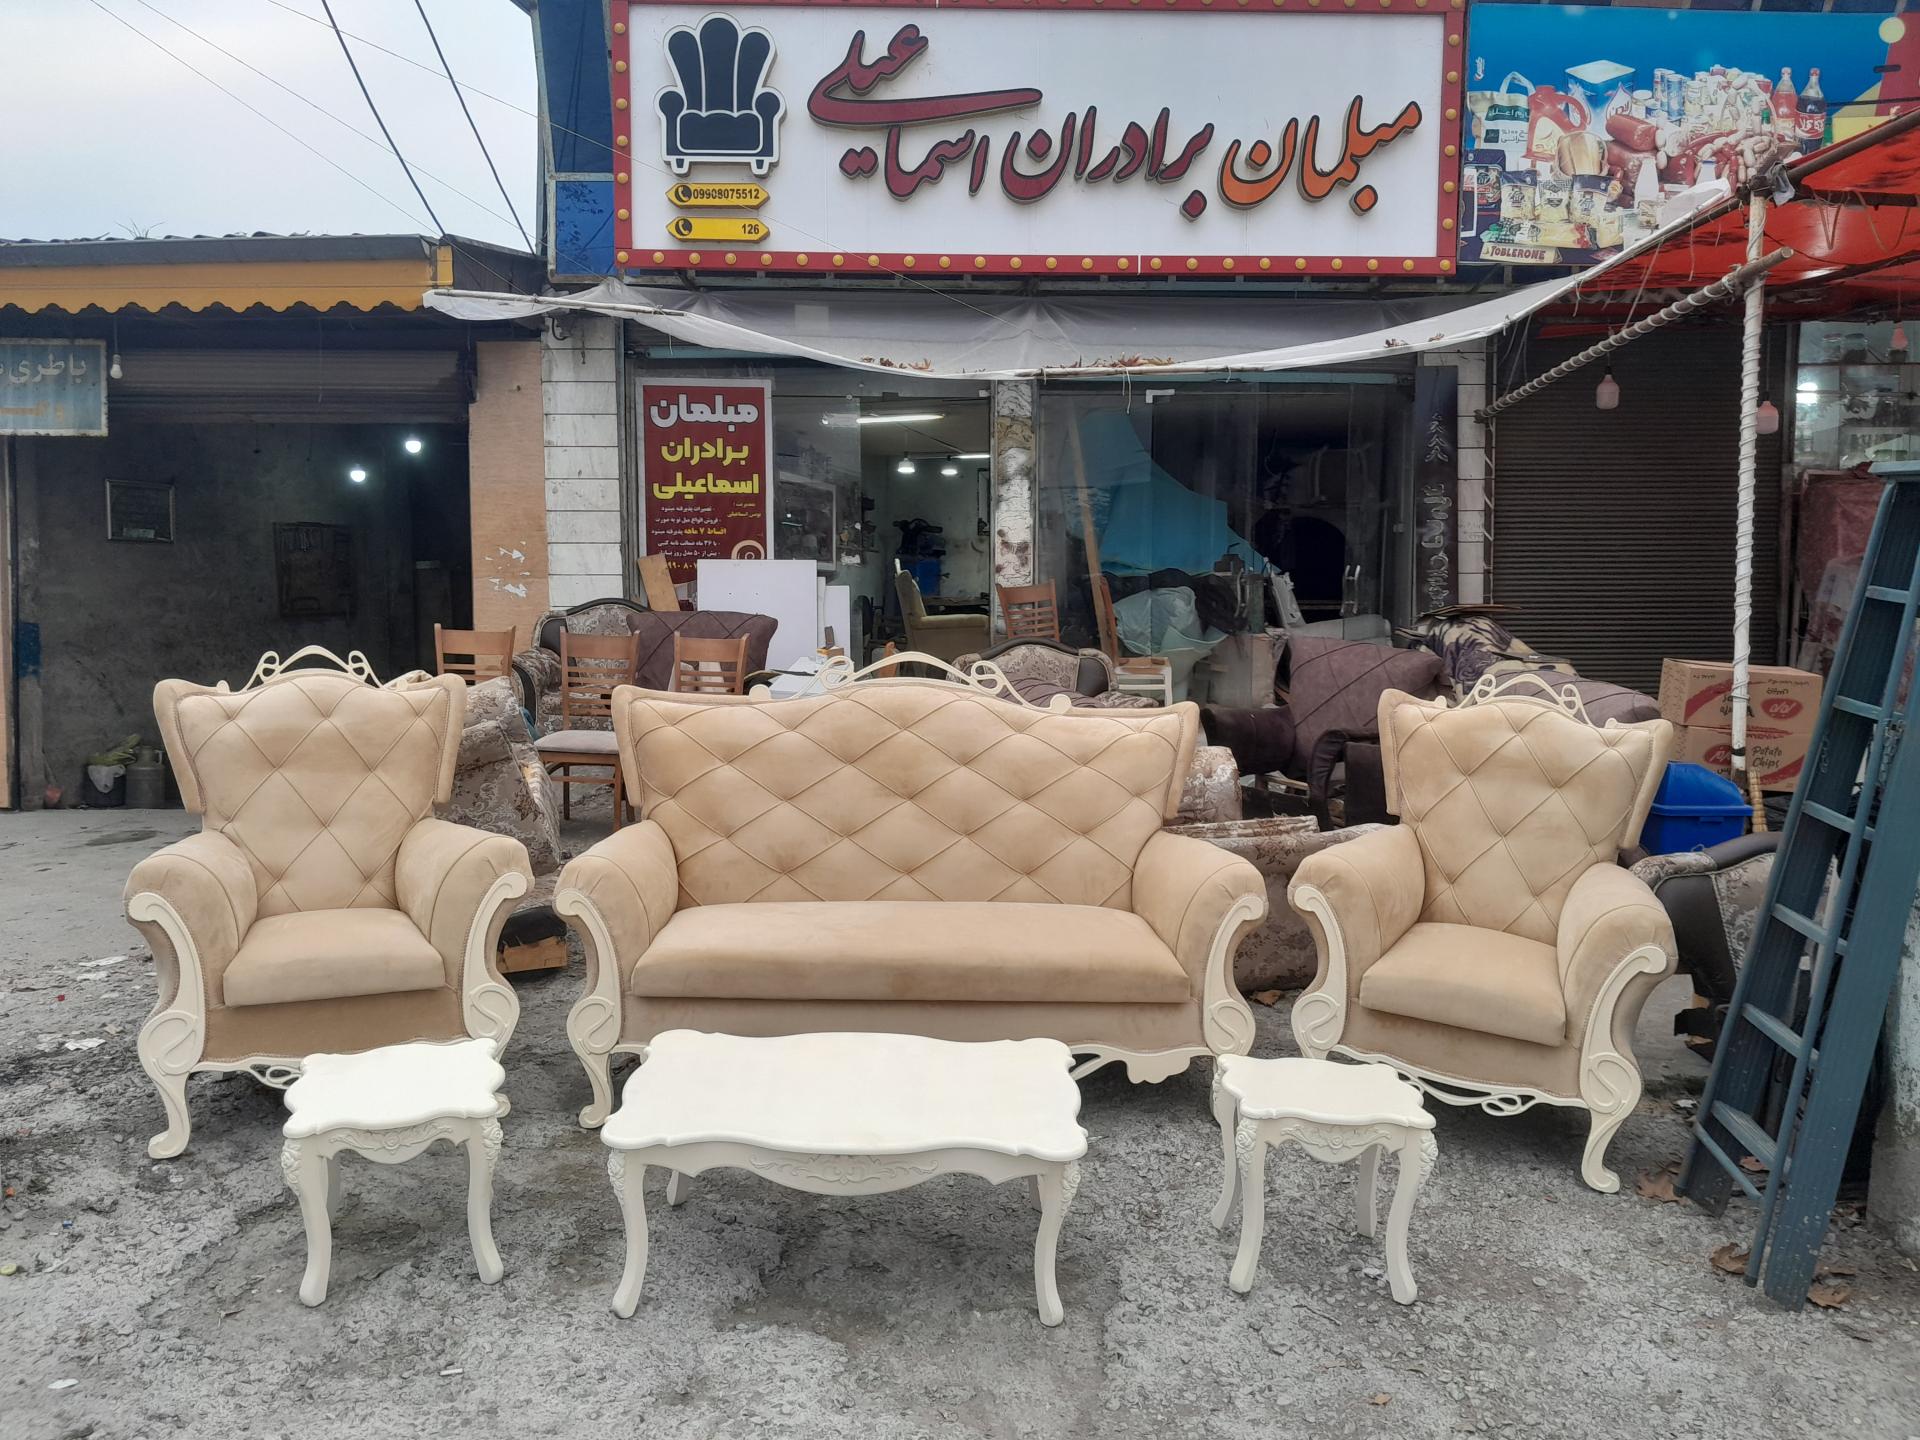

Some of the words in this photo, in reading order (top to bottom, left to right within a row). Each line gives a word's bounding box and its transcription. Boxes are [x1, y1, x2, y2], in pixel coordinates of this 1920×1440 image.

[807, 24, 1043, 202] اسماعیلی
[1001, 106, 1215, 220] برادران
[1217, 95, 1423, 214] مبلمان
[693, 188, 760, 200] 09908075512
[741, 223, 760, 235] 126
[1489, 245, 1546, 261] TOBLERONE
[8, 352, 87, 384] باطری
[650, 393, 759, 432] مبلمان
[661, 437, 750, 466] برادران
[652, 472, 760, 500] اسماعیلی
[1752, 746, 1782, 757] Potato
[1752, 757, 1780, 768] Chips
